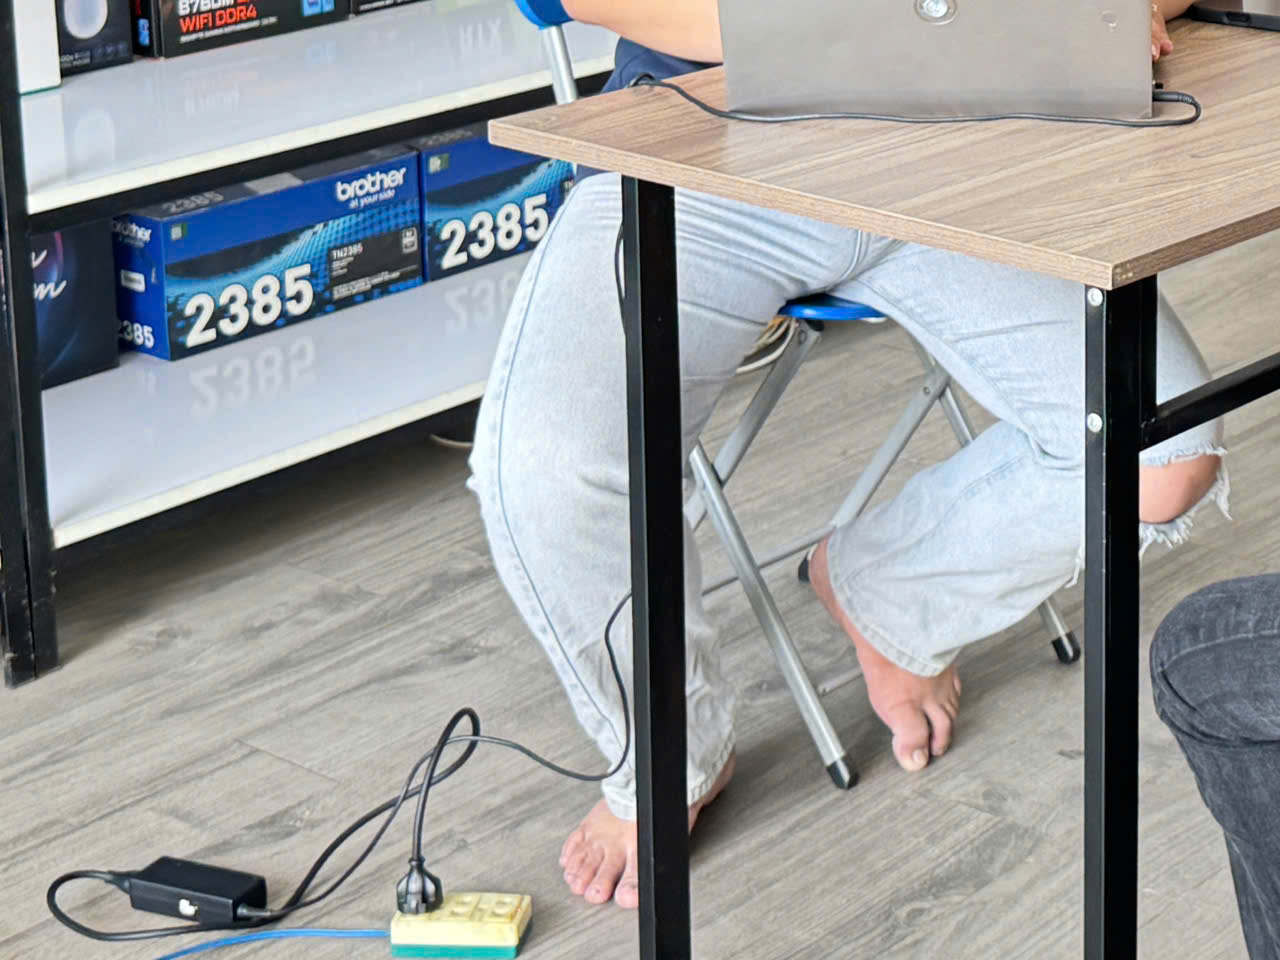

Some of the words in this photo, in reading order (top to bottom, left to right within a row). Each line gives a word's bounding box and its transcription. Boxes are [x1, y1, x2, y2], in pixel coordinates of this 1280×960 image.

[179, 15, 213, 33] WIFI
[215, 4, 257, 26] DDR4
[335, 167, 407, 202] brother
[439, 192, 550, 271] 2385
[184, 263, 314, 348] 2385
[119, 319, 155, 349] 385
